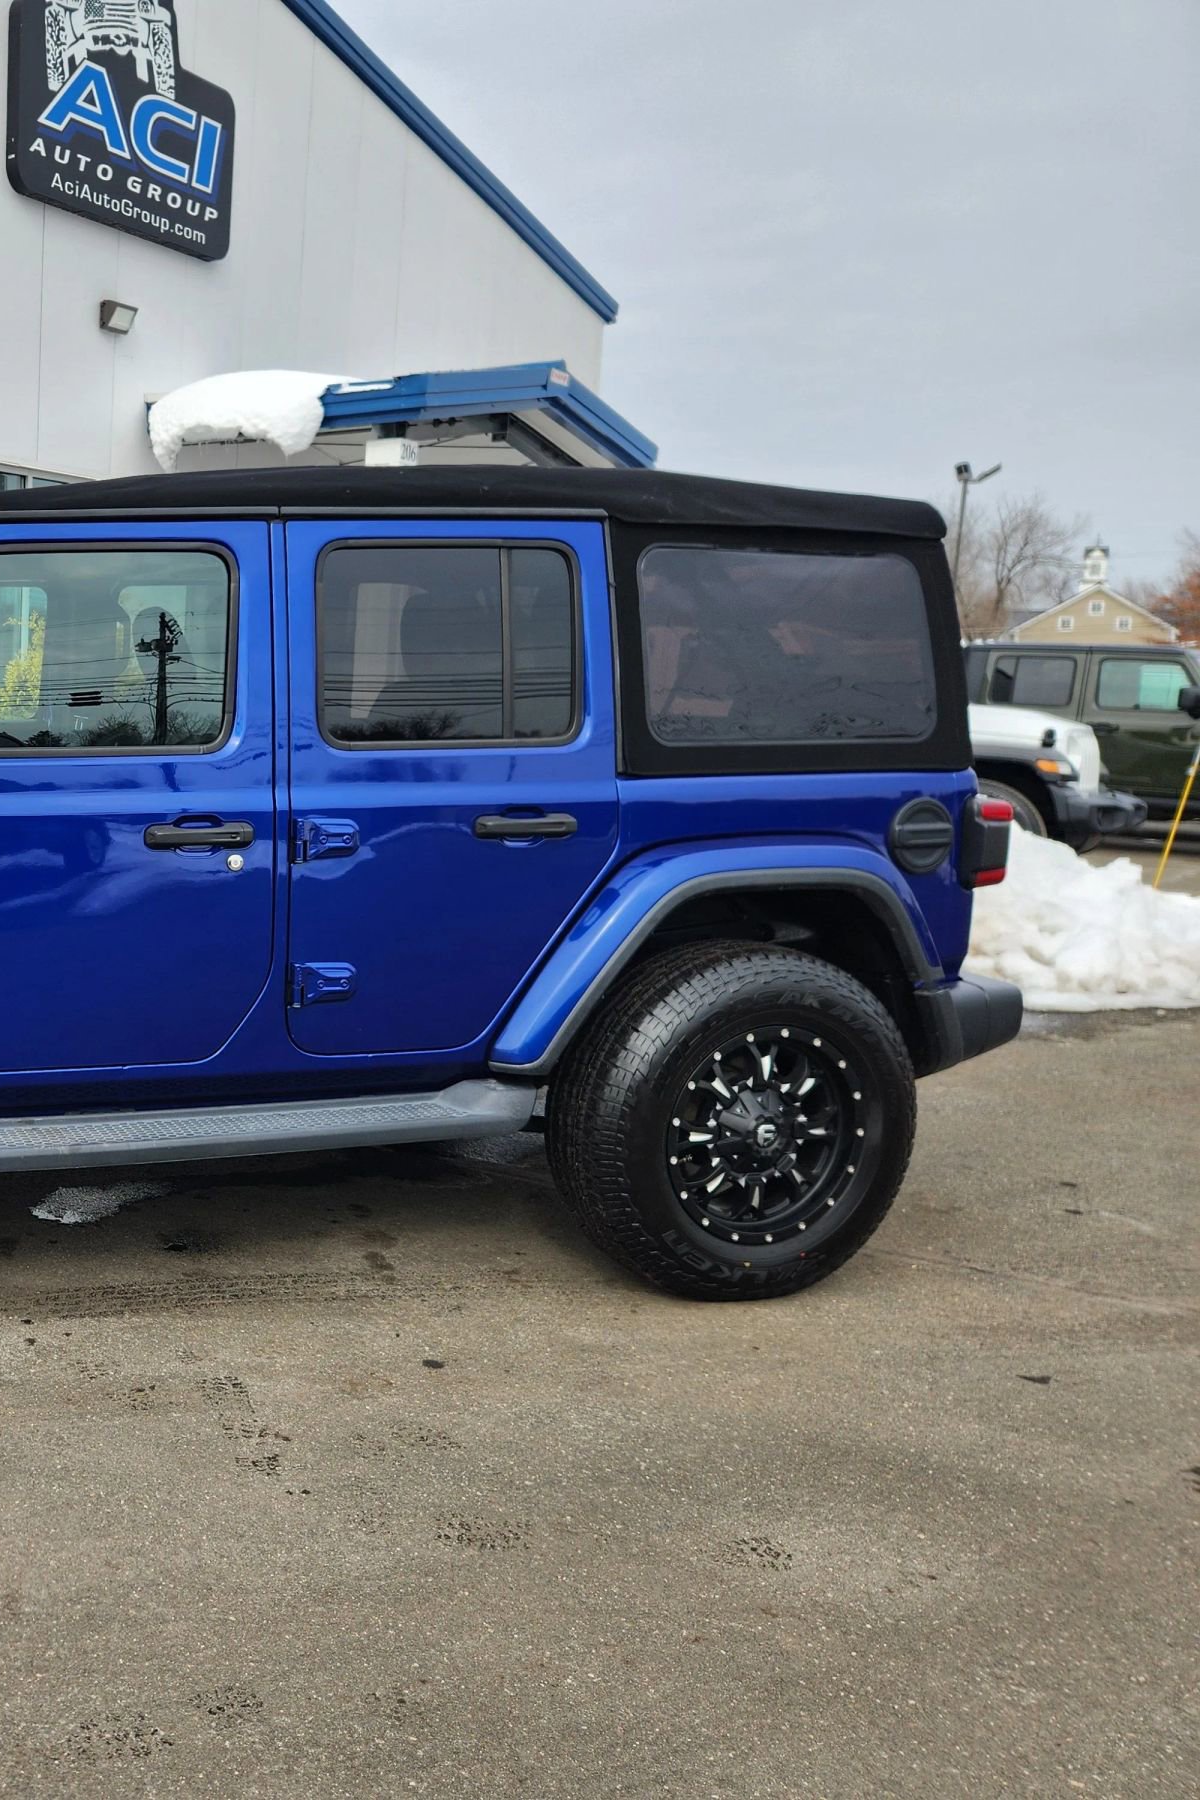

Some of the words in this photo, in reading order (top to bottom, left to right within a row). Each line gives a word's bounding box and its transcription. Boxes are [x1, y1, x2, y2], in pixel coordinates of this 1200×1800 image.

[36, 59, 224, 196] ACI
[28, 137, 115, 182] AUTO
[126, 176, 219, 222] GROUP
[50, 172, 207, 246] AciAutoGroup.com
